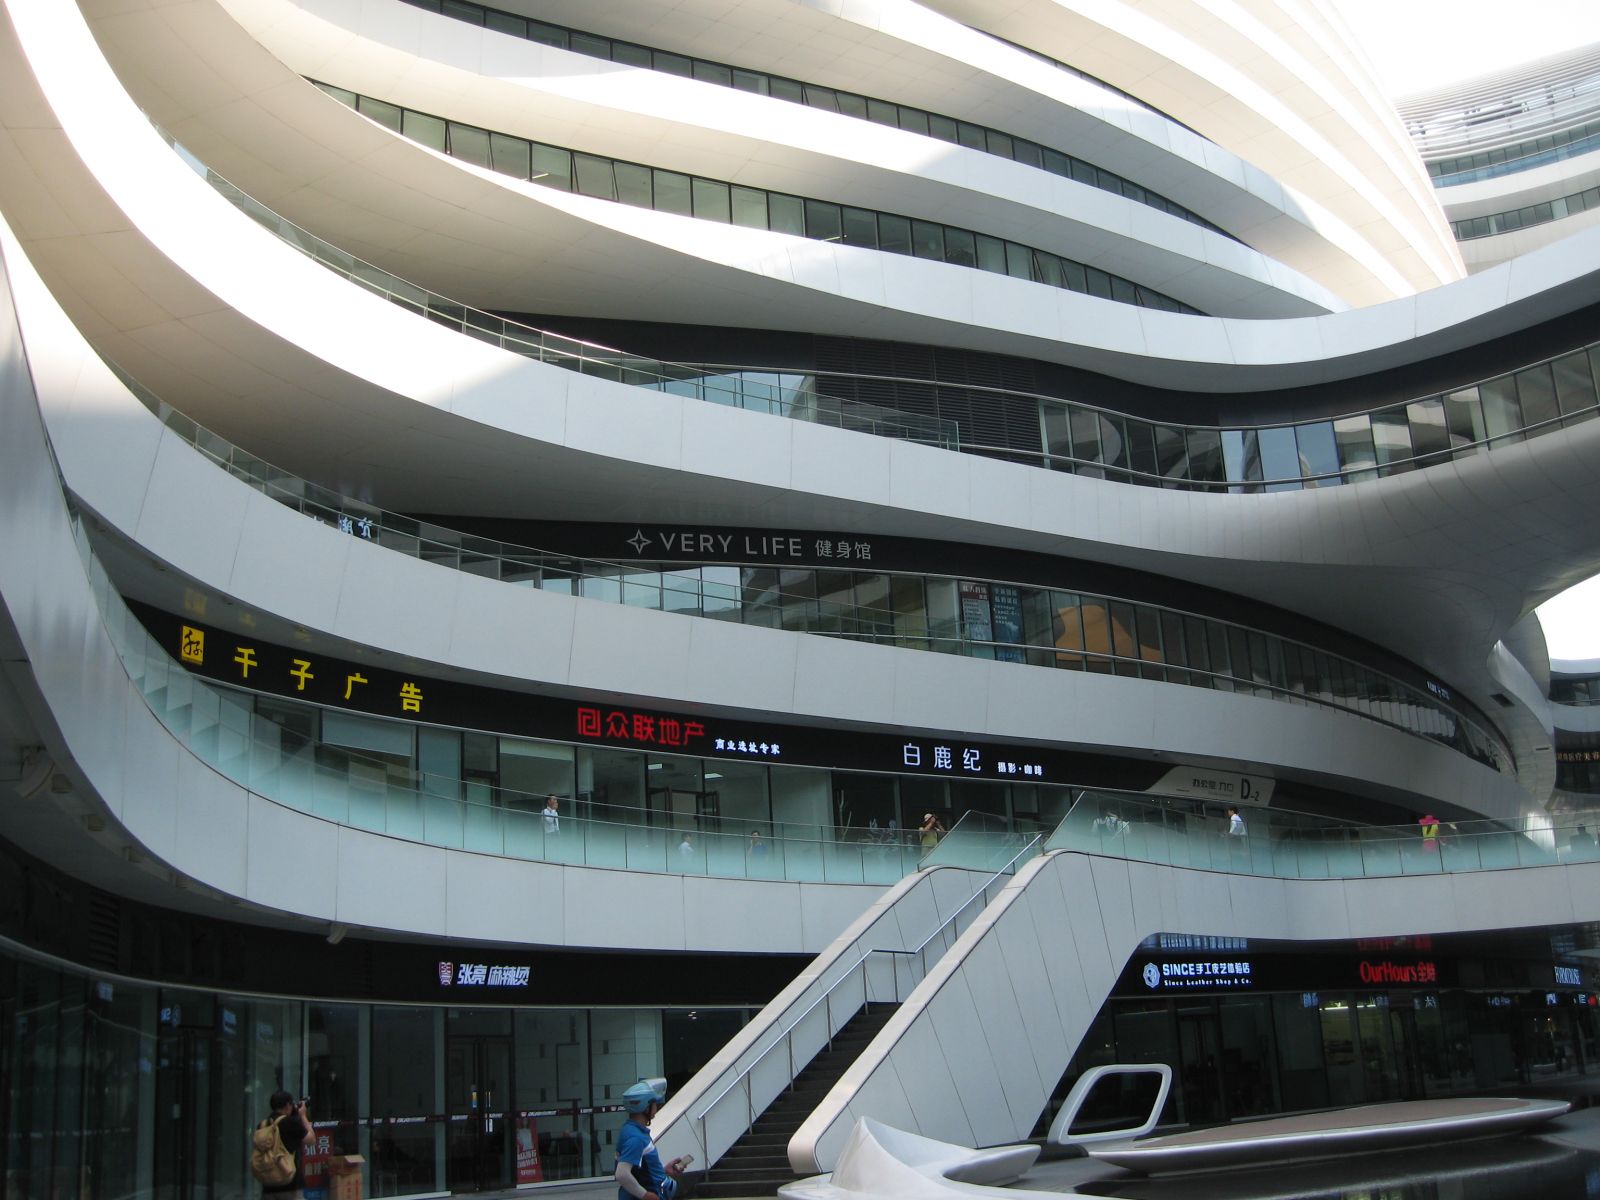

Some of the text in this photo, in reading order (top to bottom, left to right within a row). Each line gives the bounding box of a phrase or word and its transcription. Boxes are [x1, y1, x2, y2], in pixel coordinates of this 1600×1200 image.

[659, 532, 872, 560] VERY LIFE 健身馆
[233, 646, 424, 713] 千子广告
[605, 711, 705, 746] 众联地产
[903, 742, 982, 772] 白鹿纪
[1215, 978, 1232, 986] Shop
